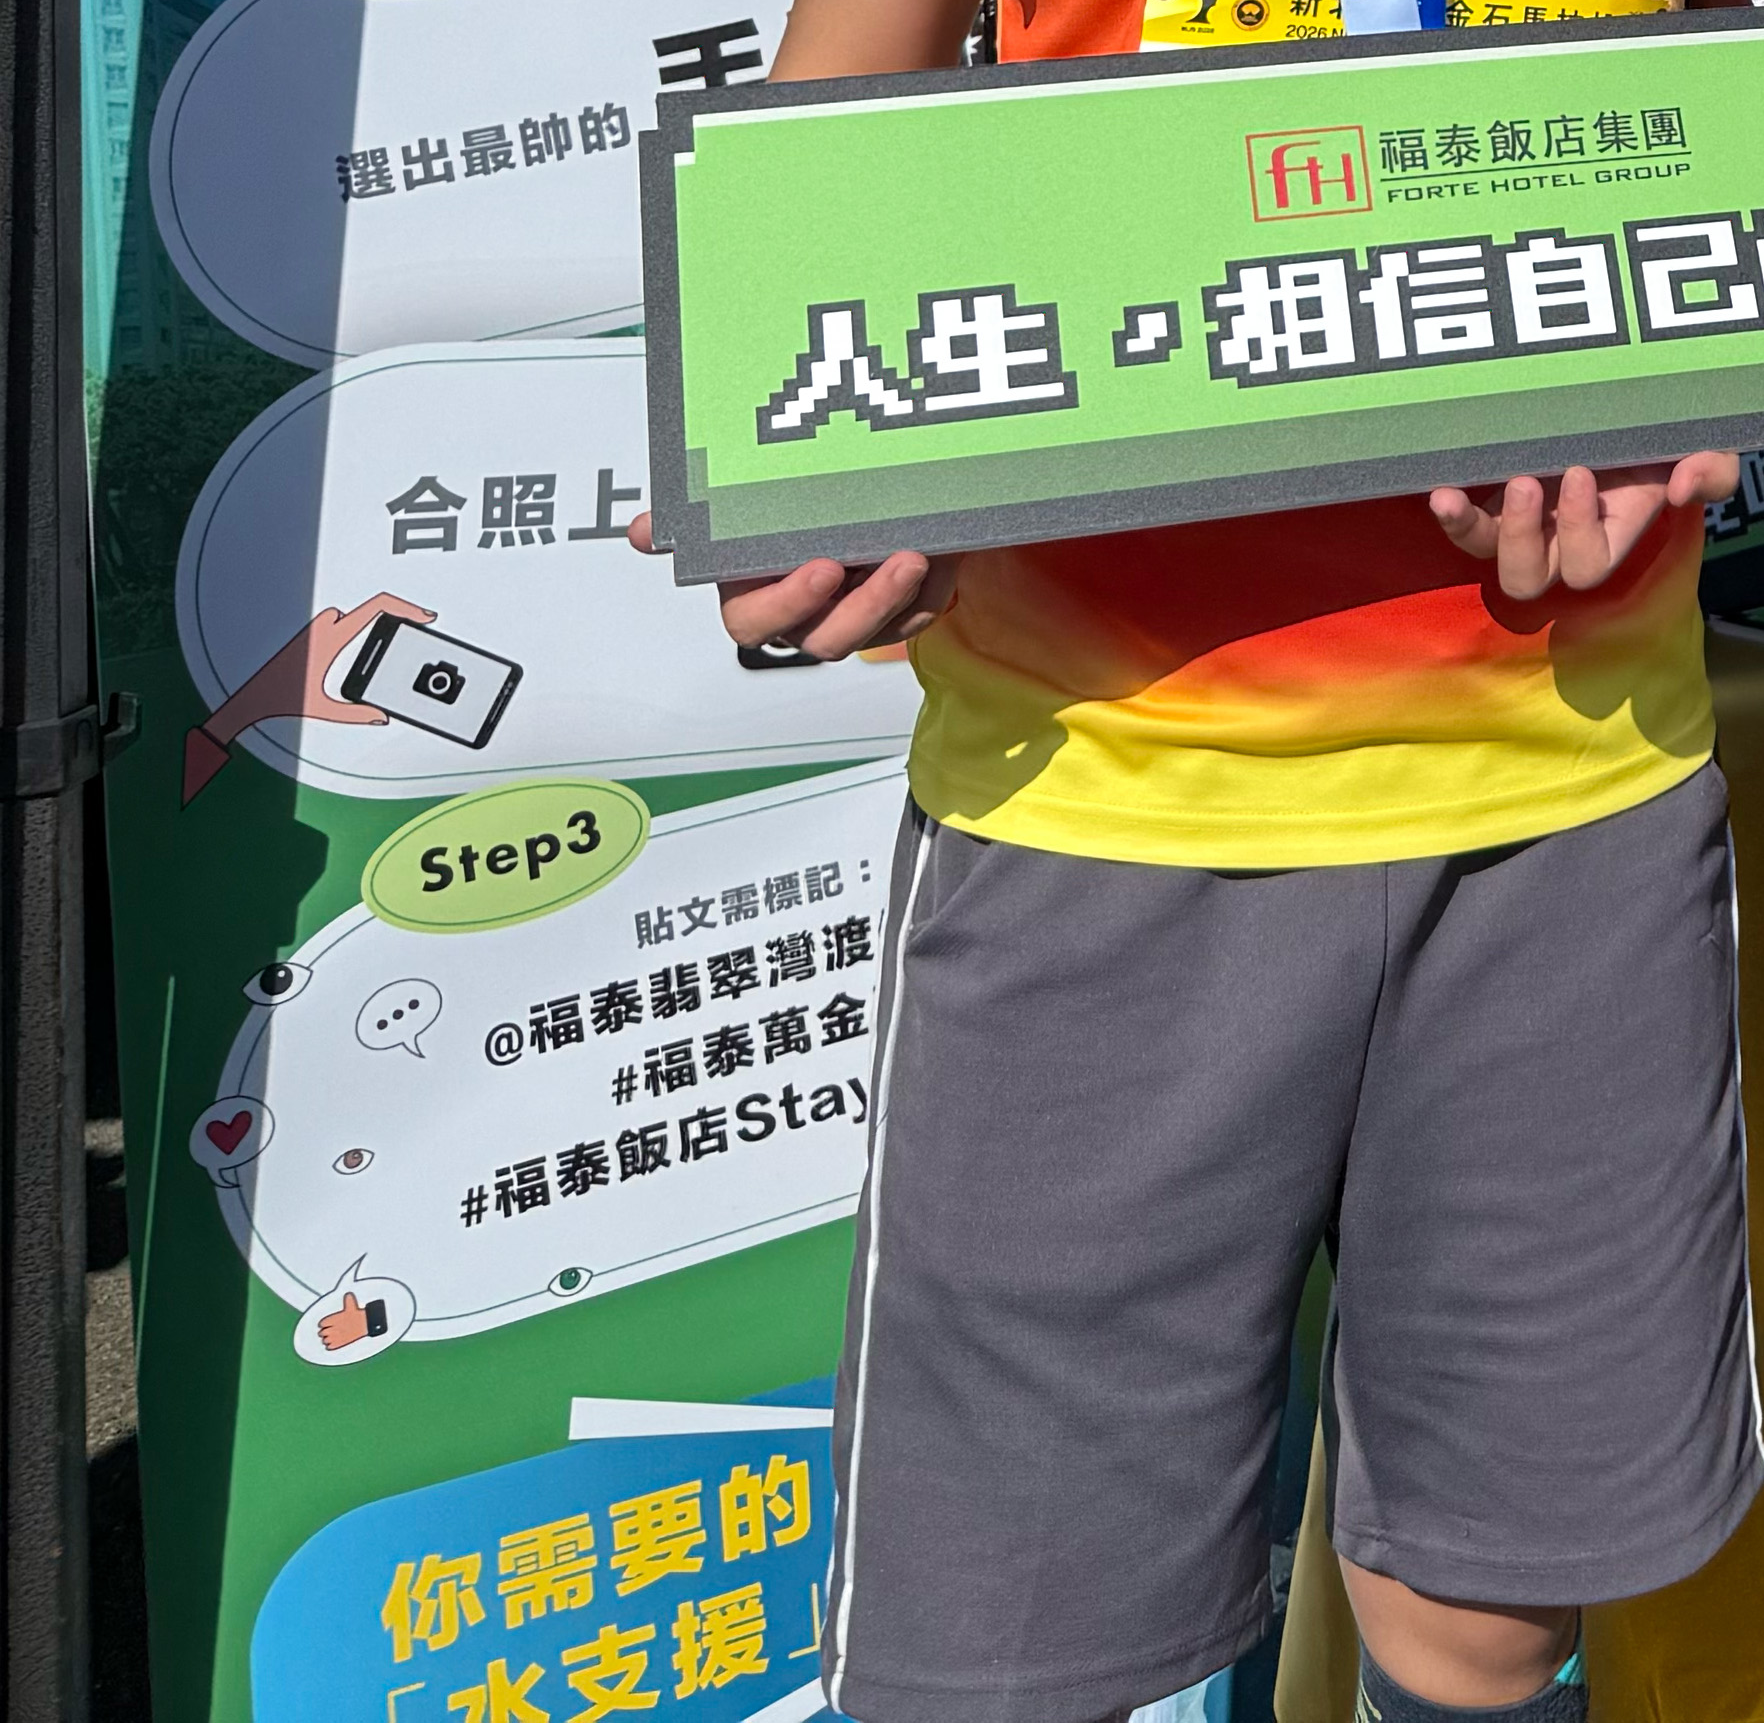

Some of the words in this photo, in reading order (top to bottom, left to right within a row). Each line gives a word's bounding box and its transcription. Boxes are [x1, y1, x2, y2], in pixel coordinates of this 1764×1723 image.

[335, 101, 632, 204] 選出最帥的
[1378, 106, 1689, 174] 福泰飯店集團
[1387, 181, 1481, 203] FORTE
[1490, 172, 1586, 194] HOTEL
[1594, 162, 1692, 184] GROUP
[418, 809, 603, 895] Step3
[380, 1453, 811, 1663] 你需要的
